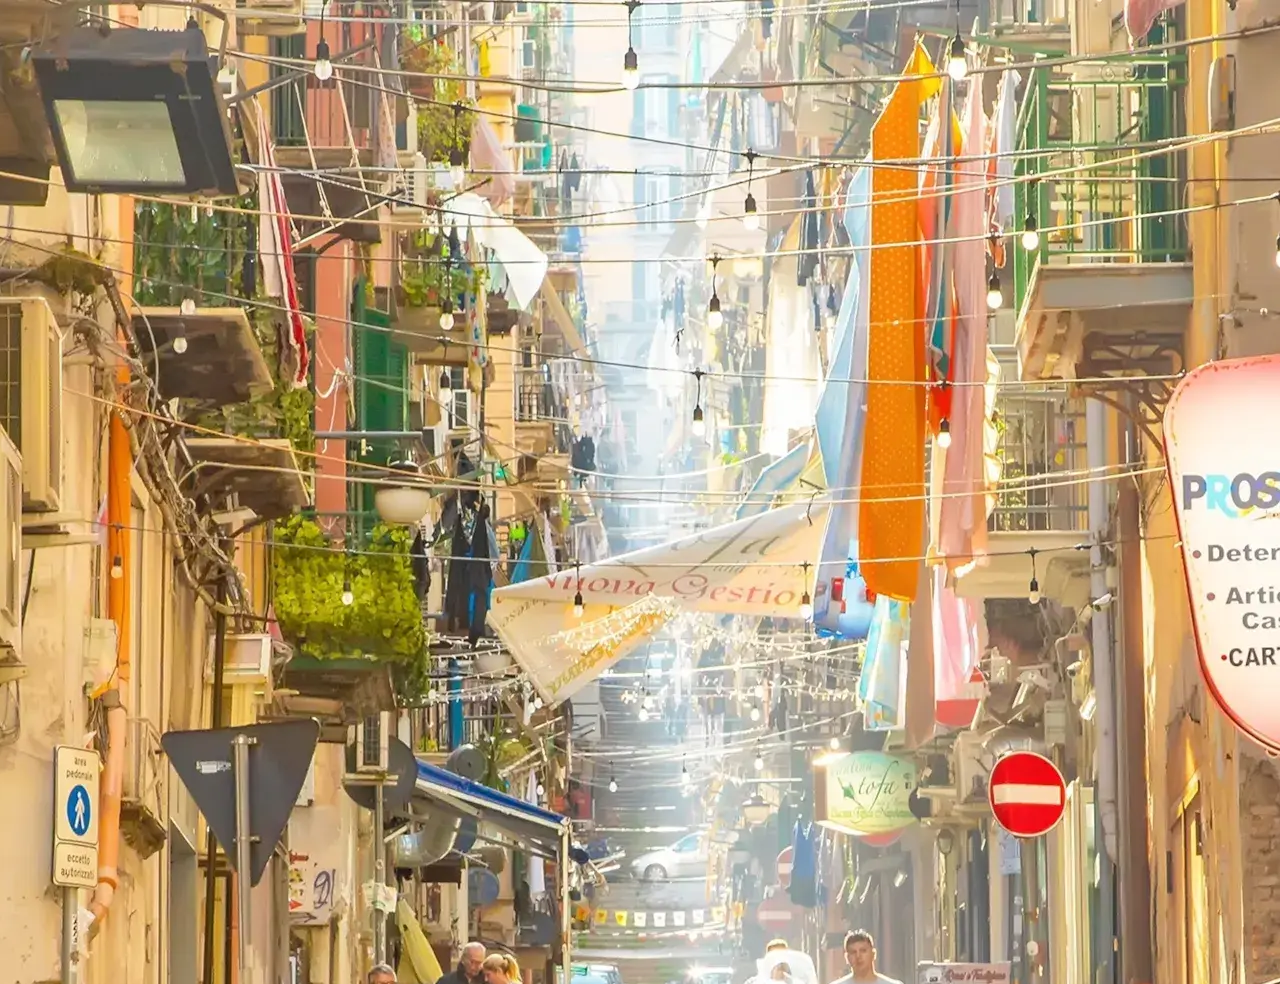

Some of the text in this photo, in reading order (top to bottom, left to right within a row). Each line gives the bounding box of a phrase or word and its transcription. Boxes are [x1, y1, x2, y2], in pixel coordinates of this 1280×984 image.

[545, 573, 807, 606] Nuova Gestio
[74, 757, 87, 767] area
[66, 769, 93, 782] pedonale
[67, 854, 90, 866] eccetto
[60, 868, 95, 881] autorizzati
